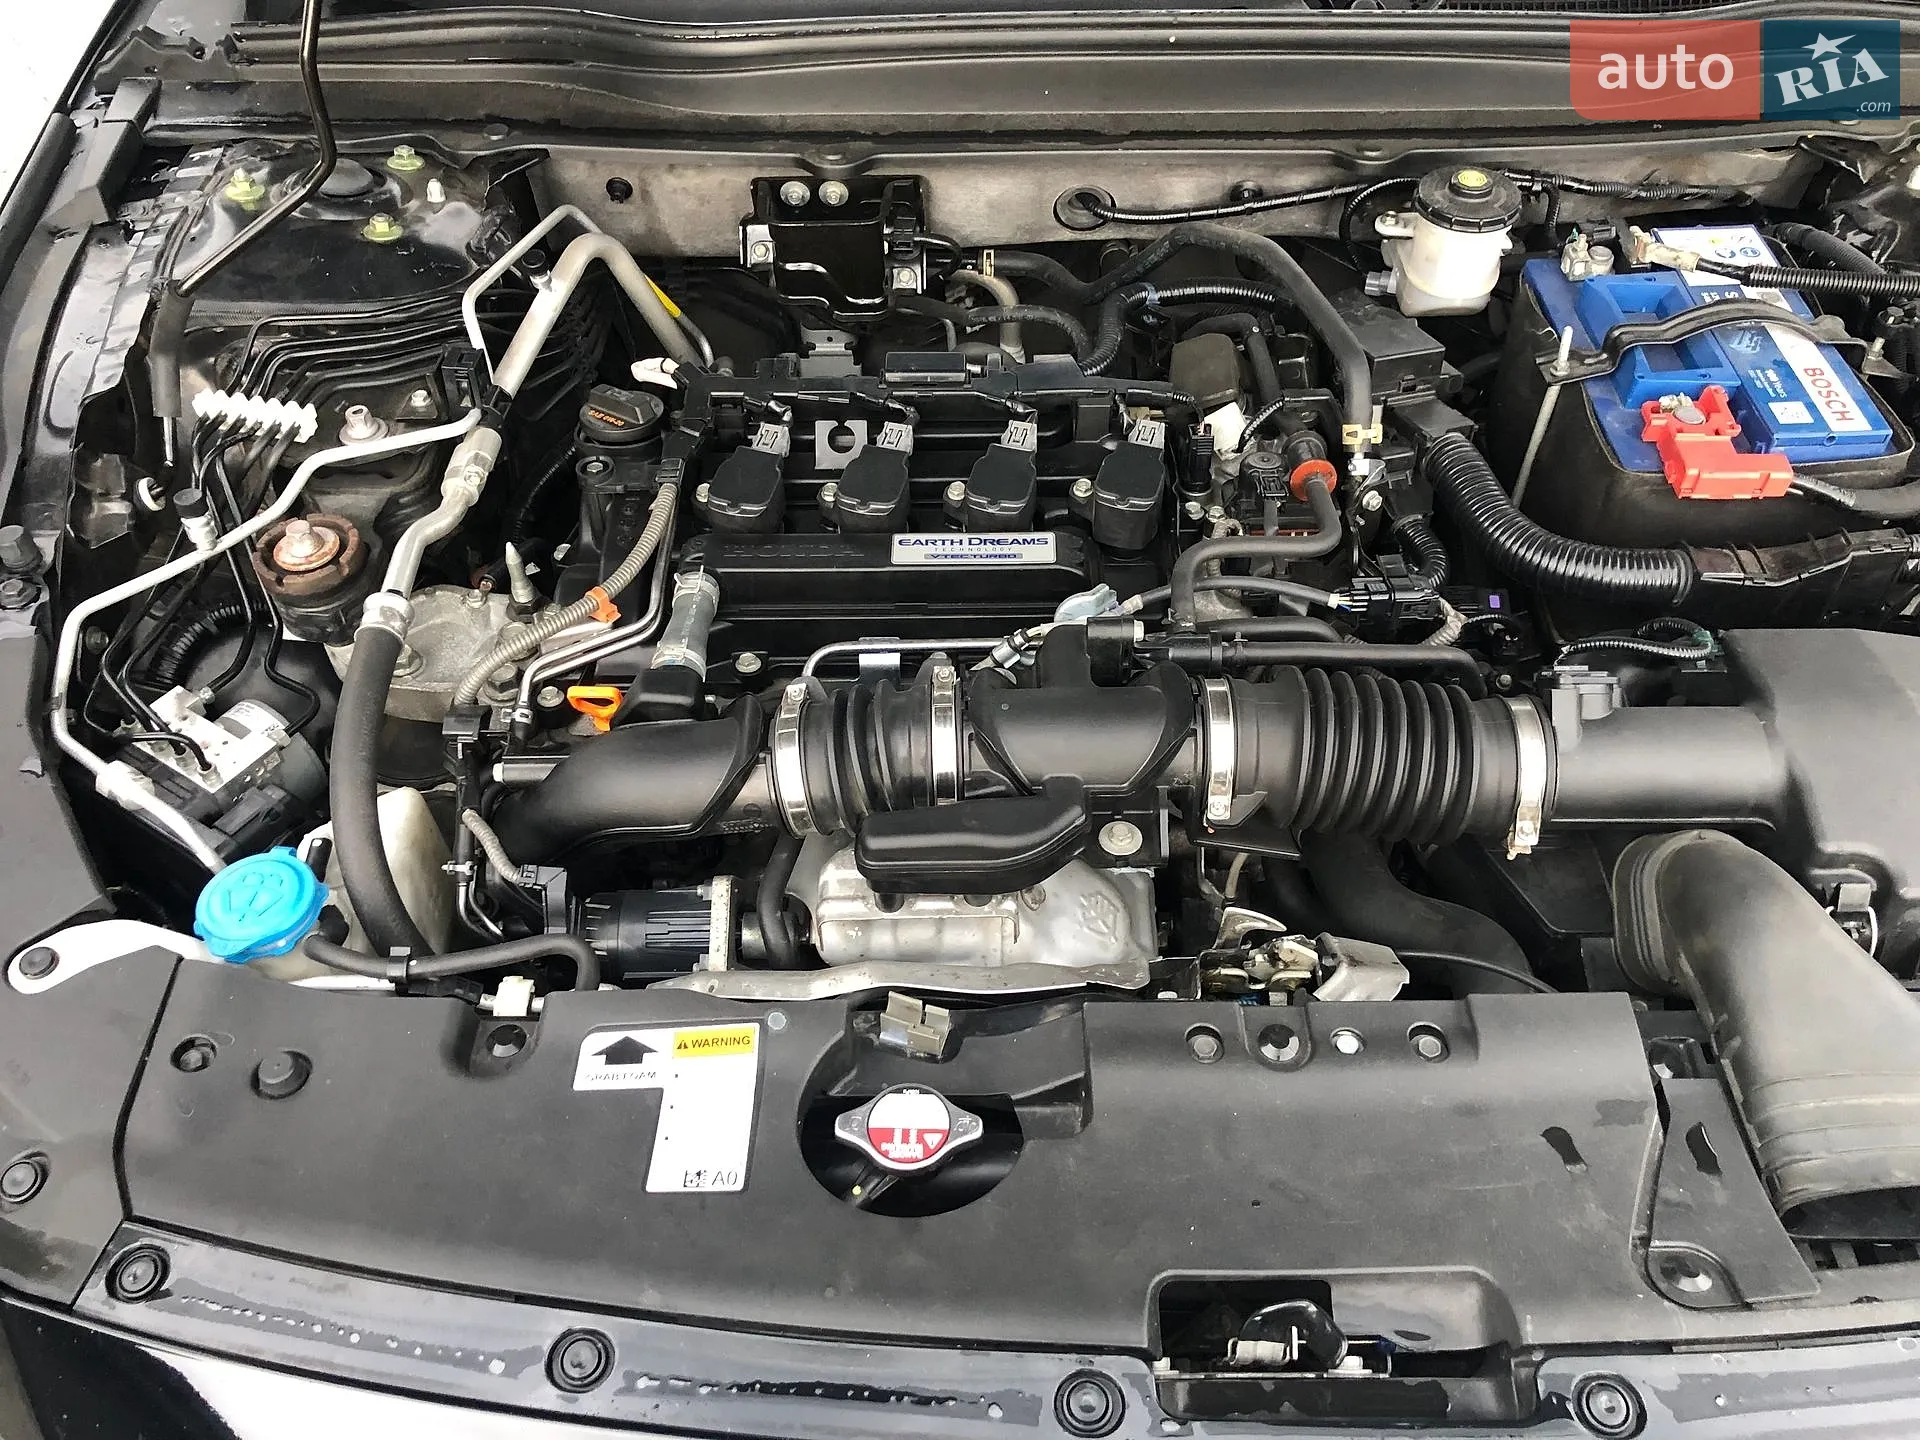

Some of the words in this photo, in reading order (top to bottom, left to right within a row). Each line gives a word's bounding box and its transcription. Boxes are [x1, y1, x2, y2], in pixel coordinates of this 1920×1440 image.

[1803, 367, 1855, 421] BOSCH
[898, 538, 963, 546] EARTH
[967, 537, 1049, 546] DREAMS
[691, 1035, 751, 1049] WARNING
